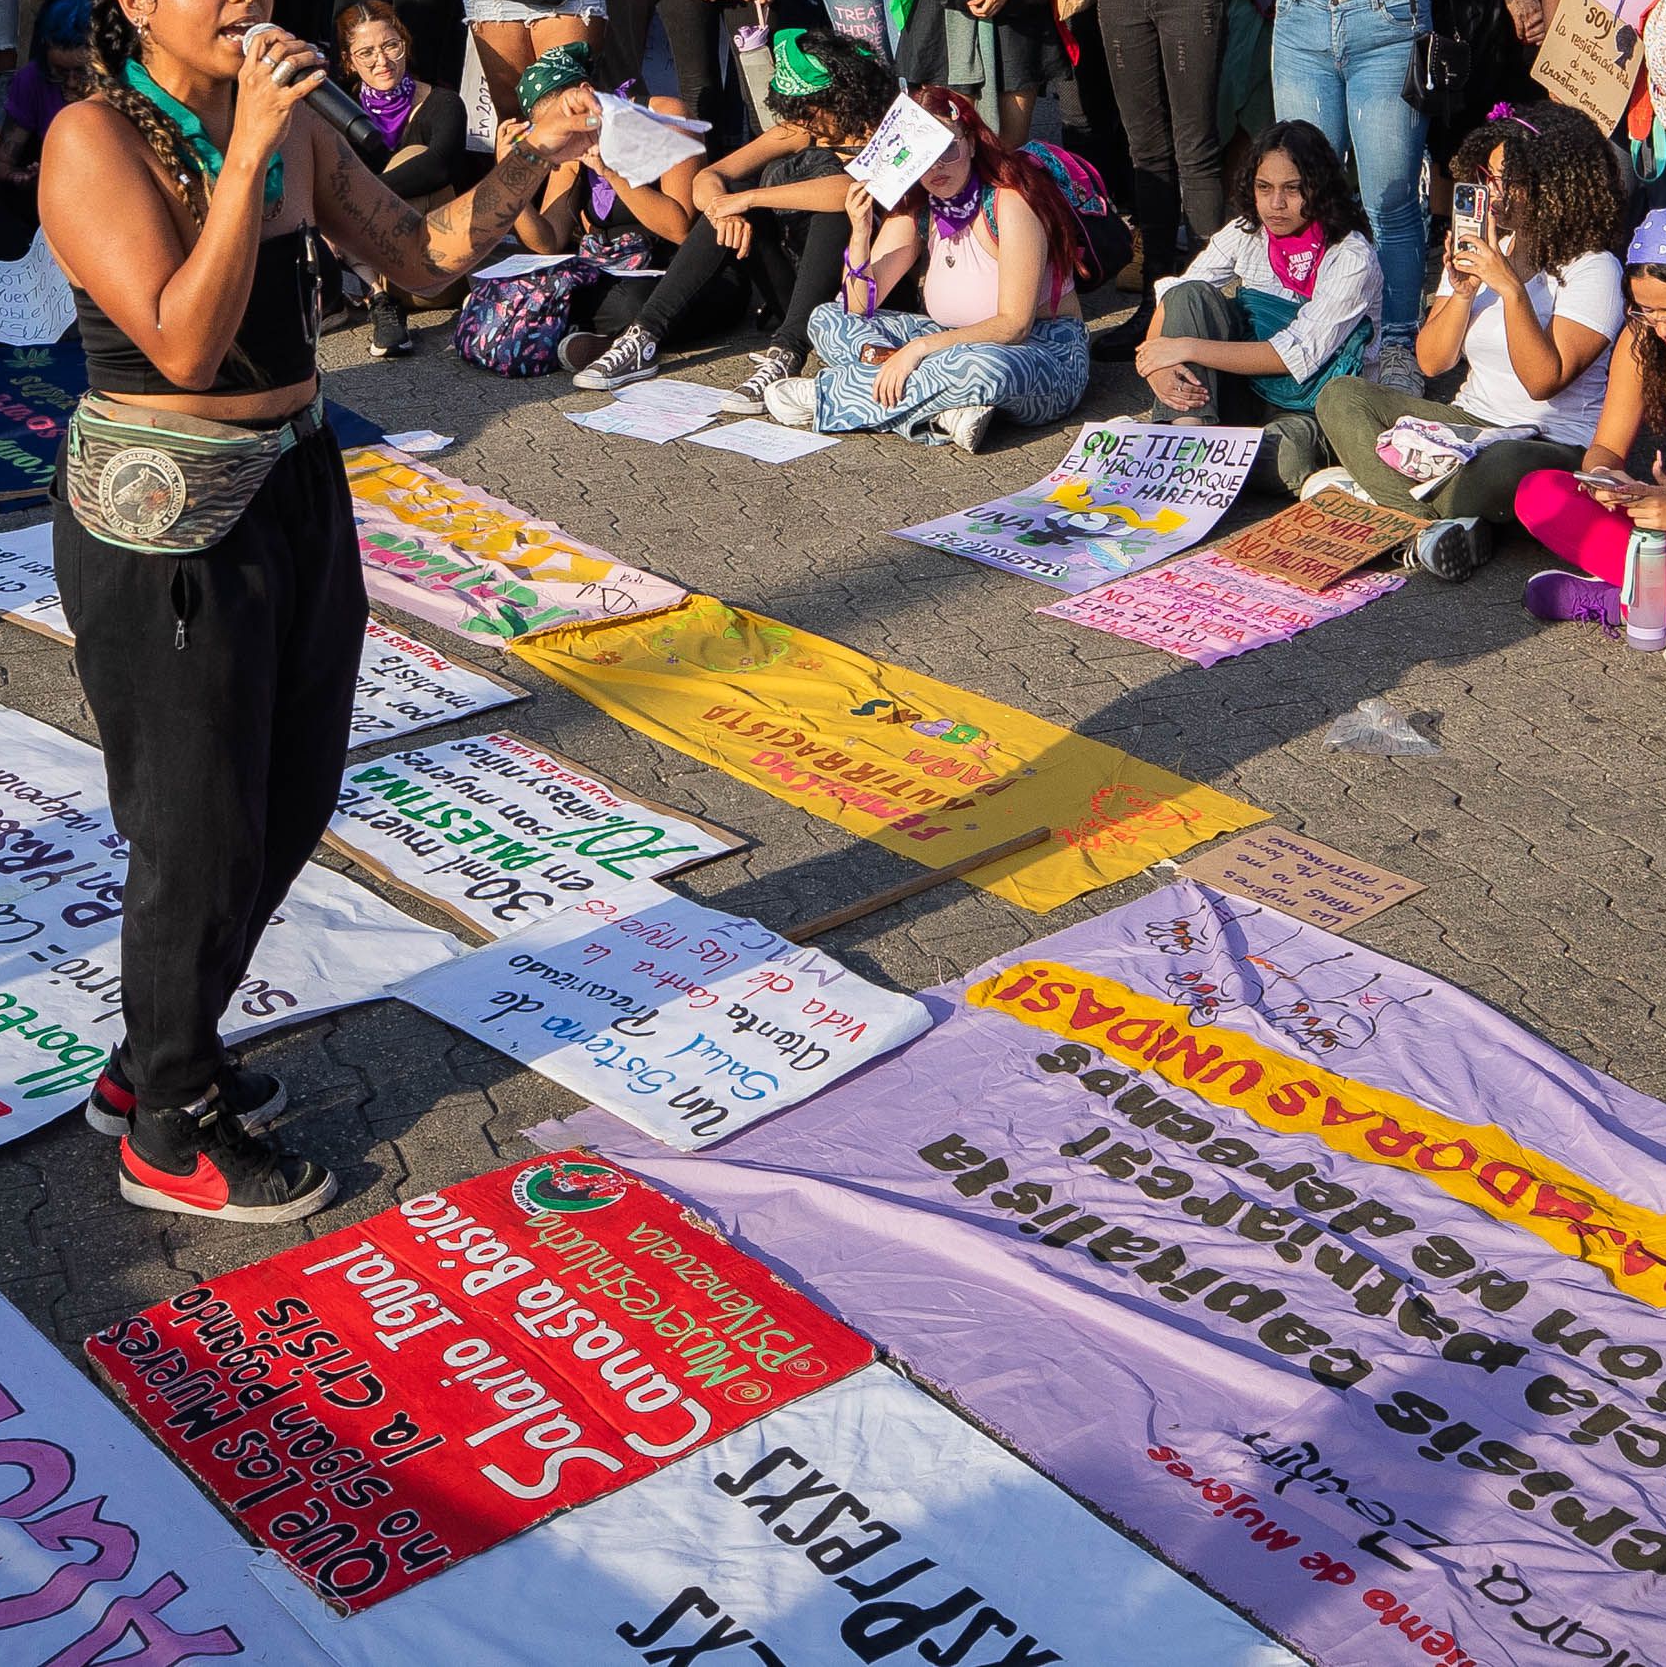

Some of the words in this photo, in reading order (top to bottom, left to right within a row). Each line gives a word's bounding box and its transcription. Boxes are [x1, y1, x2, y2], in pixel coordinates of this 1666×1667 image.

[1555, 14, 1567, 37] la
[1571, 34, 1614, 76] resistencia
[1581, 69, 1598, 85] mis
[1061, 454, 1091, 474] EL
[1101, 457, 1166, 480] MACHO
[1167, 461, 1244, 492] PORQUE
[1083, 430, 1136, 458] QUE
[1148, 434, 1259, 467] TIEMBLE
[963, 506, 1034, 532] UNA
[1133, 485, 1234, 509] HAREMOS
[1311, 491, 1378, 524] QUIEN
[1376, 514, 1417, 535] AMA
[1257, 519, 1302, 545] NO
[1291, 534, 1367, 565] HUMILLA
[1284, 505, 1325, 530] NO
[1320, 519, 1375, 545] MATA
[1225, 533, 1272, 560] NO
[1258, 548, 1345, 582] MALTRATA
[1097, 589, 1134, 605] NO
[1135, 598, 1164, 616] ES
[1193, 616, 1245, 643] HORA
[376, 654, 475, 712] machista
[393, 748, 501, 812] mujeres
[904, 747, 1020, 797] PARA
[348, 764, 544, 872] PALESTINA
[498, 797, 553, 839] son
[555, 813, 698, 881] 70%
[1236, 853, 1267, 870] me
[1244, 838, 1285, 862] borra
[1268, 837, 1380, 886] PATRIARCADO
[544, 862, 594, 896] en
[1222, 869, 1298, 909] mujeres
[1273, 873, 1293, 886] no
[1303, 889, 1366, 916] TRANS
[584, 942, 612, 972] la
[696, 937, 741, 977] las
[491, 990, 543, 1026] de
[744, 971, 794, 1001] de
[541, 1012, 676, 1095] Sistema
[992, 964, 1262, 1094] UNIDAS!
[677, 1033, 779, 1102] Salud
[668, 1085, 731, 1137] Un
[1037, 1041, 1414, 1238] derechos
[400, 1191, 536, 1300] Básica
[918, 1133, 1374, 1392] capitalista
[1060, 1129, 1529, 1380] patriarcal
[302, 1237, 461, 1353] Igual
[256, 1296, 385, 1410] Crisis
[512, 1280, 714, 1459] Canasta
[369, 1411, 446, 1468] la
[440, 1335, 624, 1500] Salario
[214, 1429, 307, 1517] Las
[270, 1401, 394, 1510] sigan
[1145, 1443, 1301, 1554] Mujeres
[376, 1509, 448, 1575] no
[1299, 1550, 1357, 1586] de
